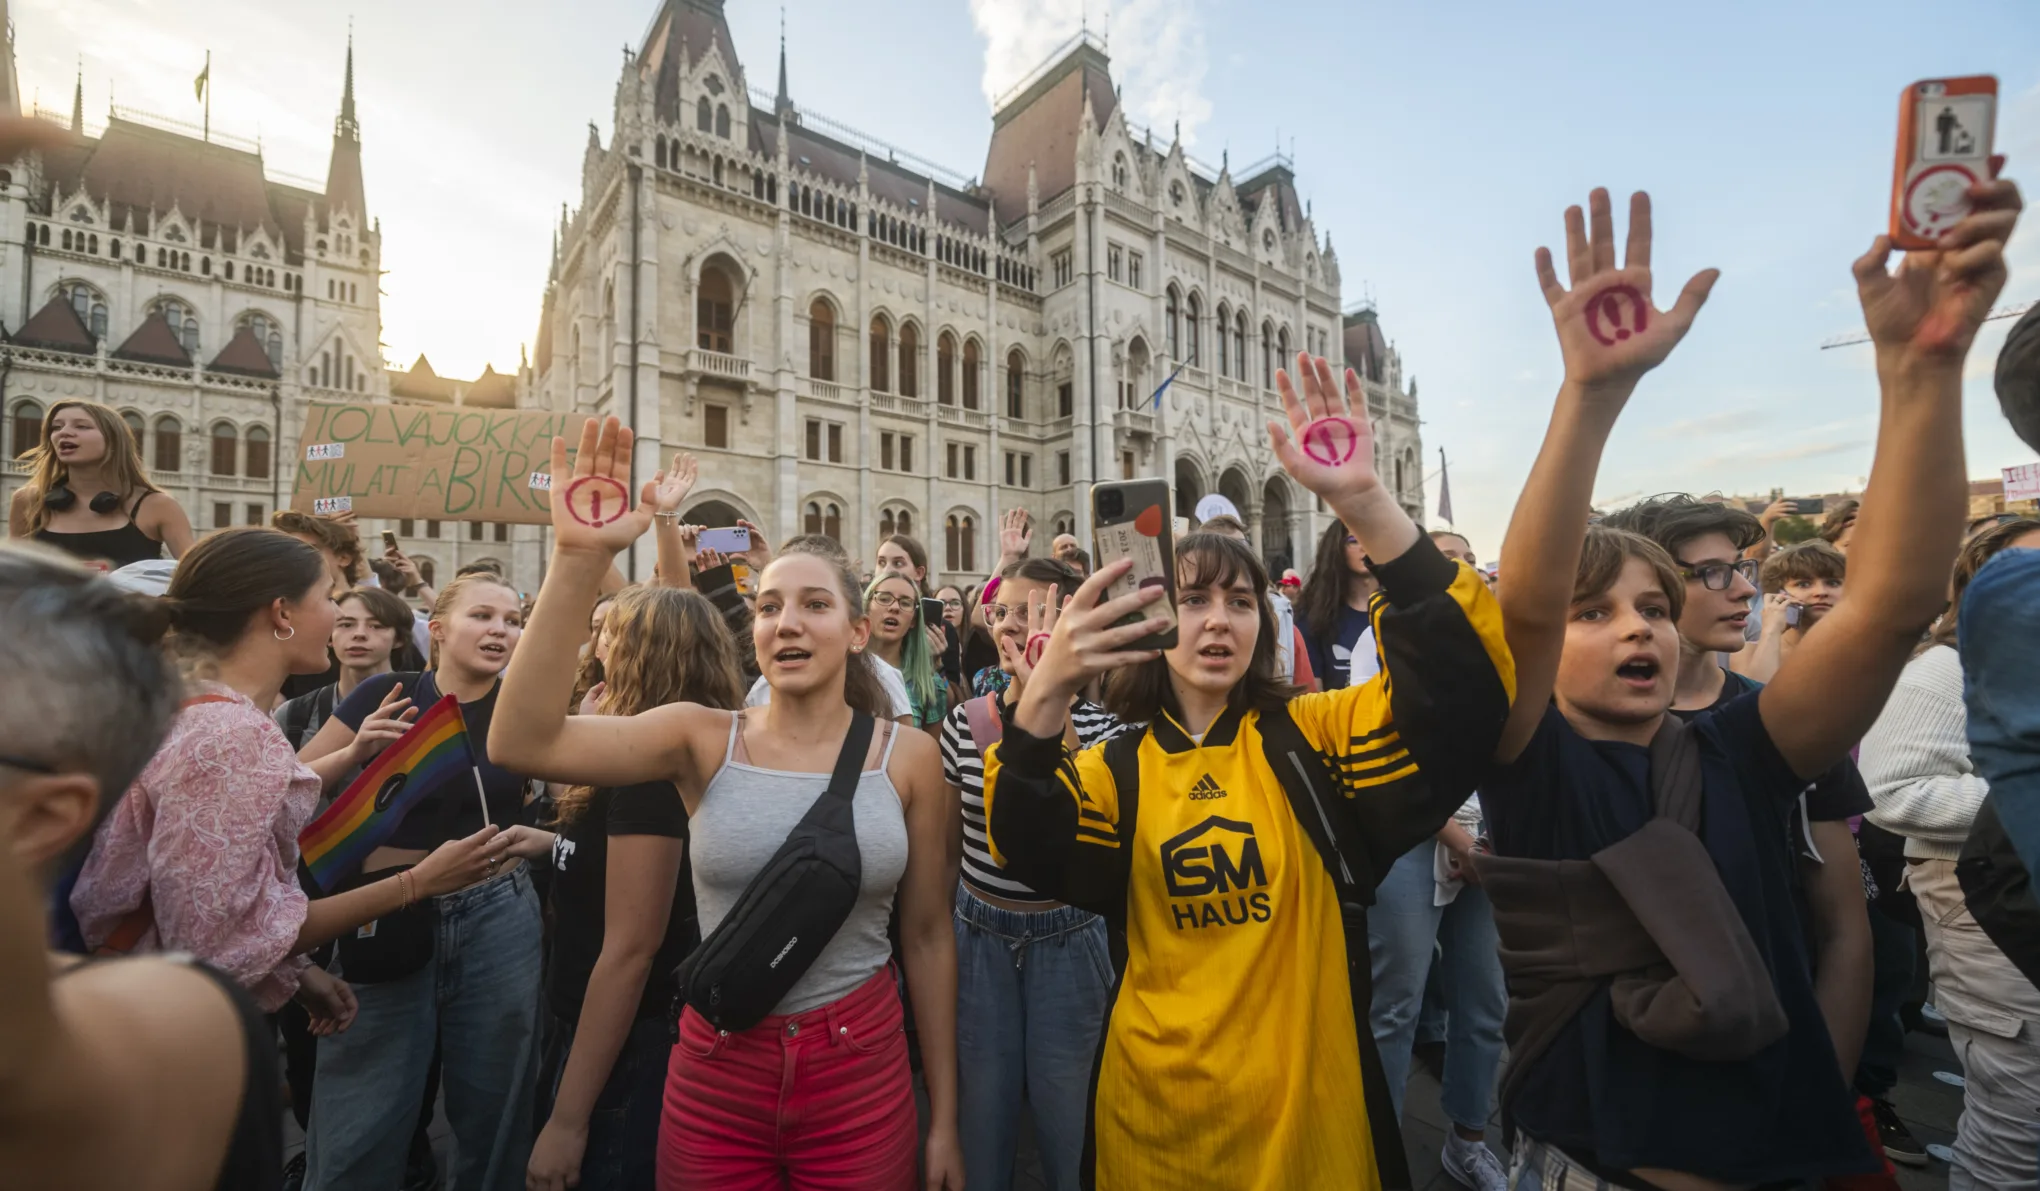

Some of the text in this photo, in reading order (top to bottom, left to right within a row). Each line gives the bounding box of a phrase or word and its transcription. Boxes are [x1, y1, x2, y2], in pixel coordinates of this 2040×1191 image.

[293, 460, 412, 498] MULAT
[416, 466, 445, 497] A
[1188, 788, 1228, 801] adidas
[1169, 836, 1268, 897] SM
[1171, 892, 1272, 930] HAUS
